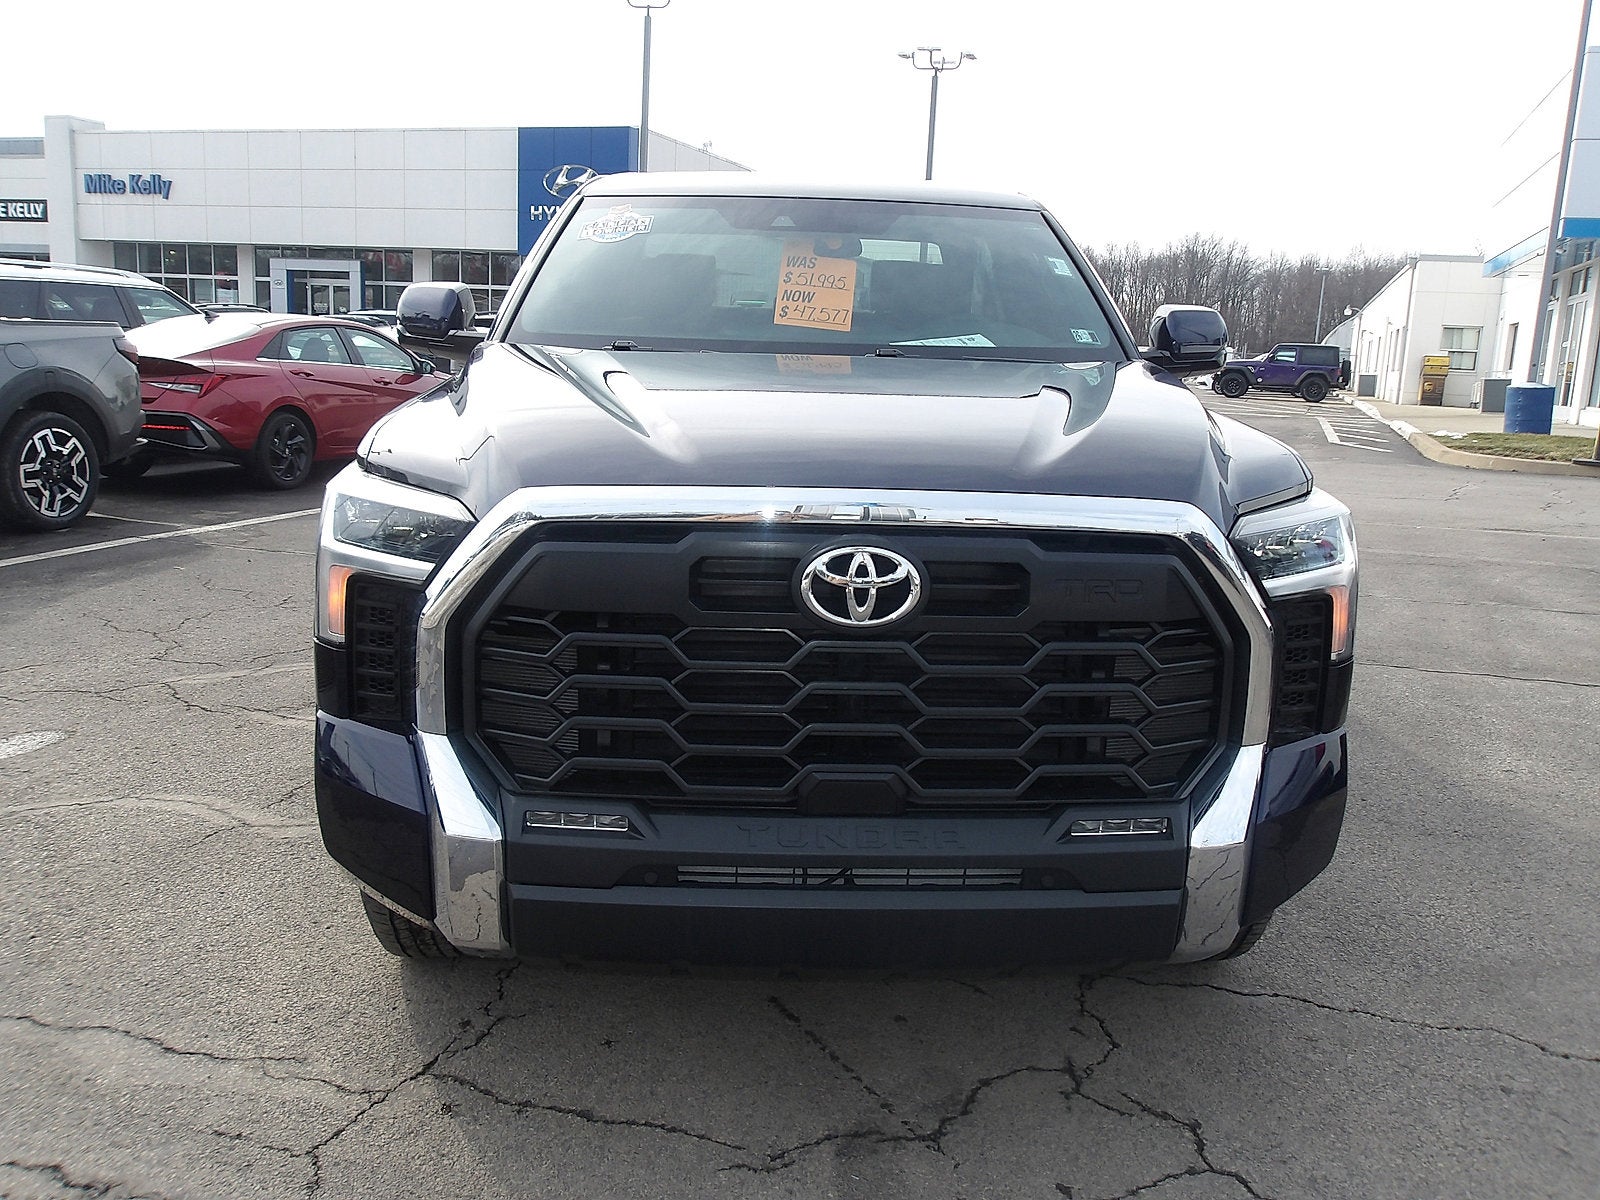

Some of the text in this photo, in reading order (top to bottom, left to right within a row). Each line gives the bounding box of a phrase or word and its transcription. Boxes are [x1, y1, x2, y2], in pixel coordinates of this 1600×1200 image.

[83, 173, 173, 200] Mike Kelly
[7, 202, 45, 219] KELLY
[786, 255, 817, 269] WAS
[781, 289, 816, 304] NOW
[736, 823, 966, 850] TUNDRA
